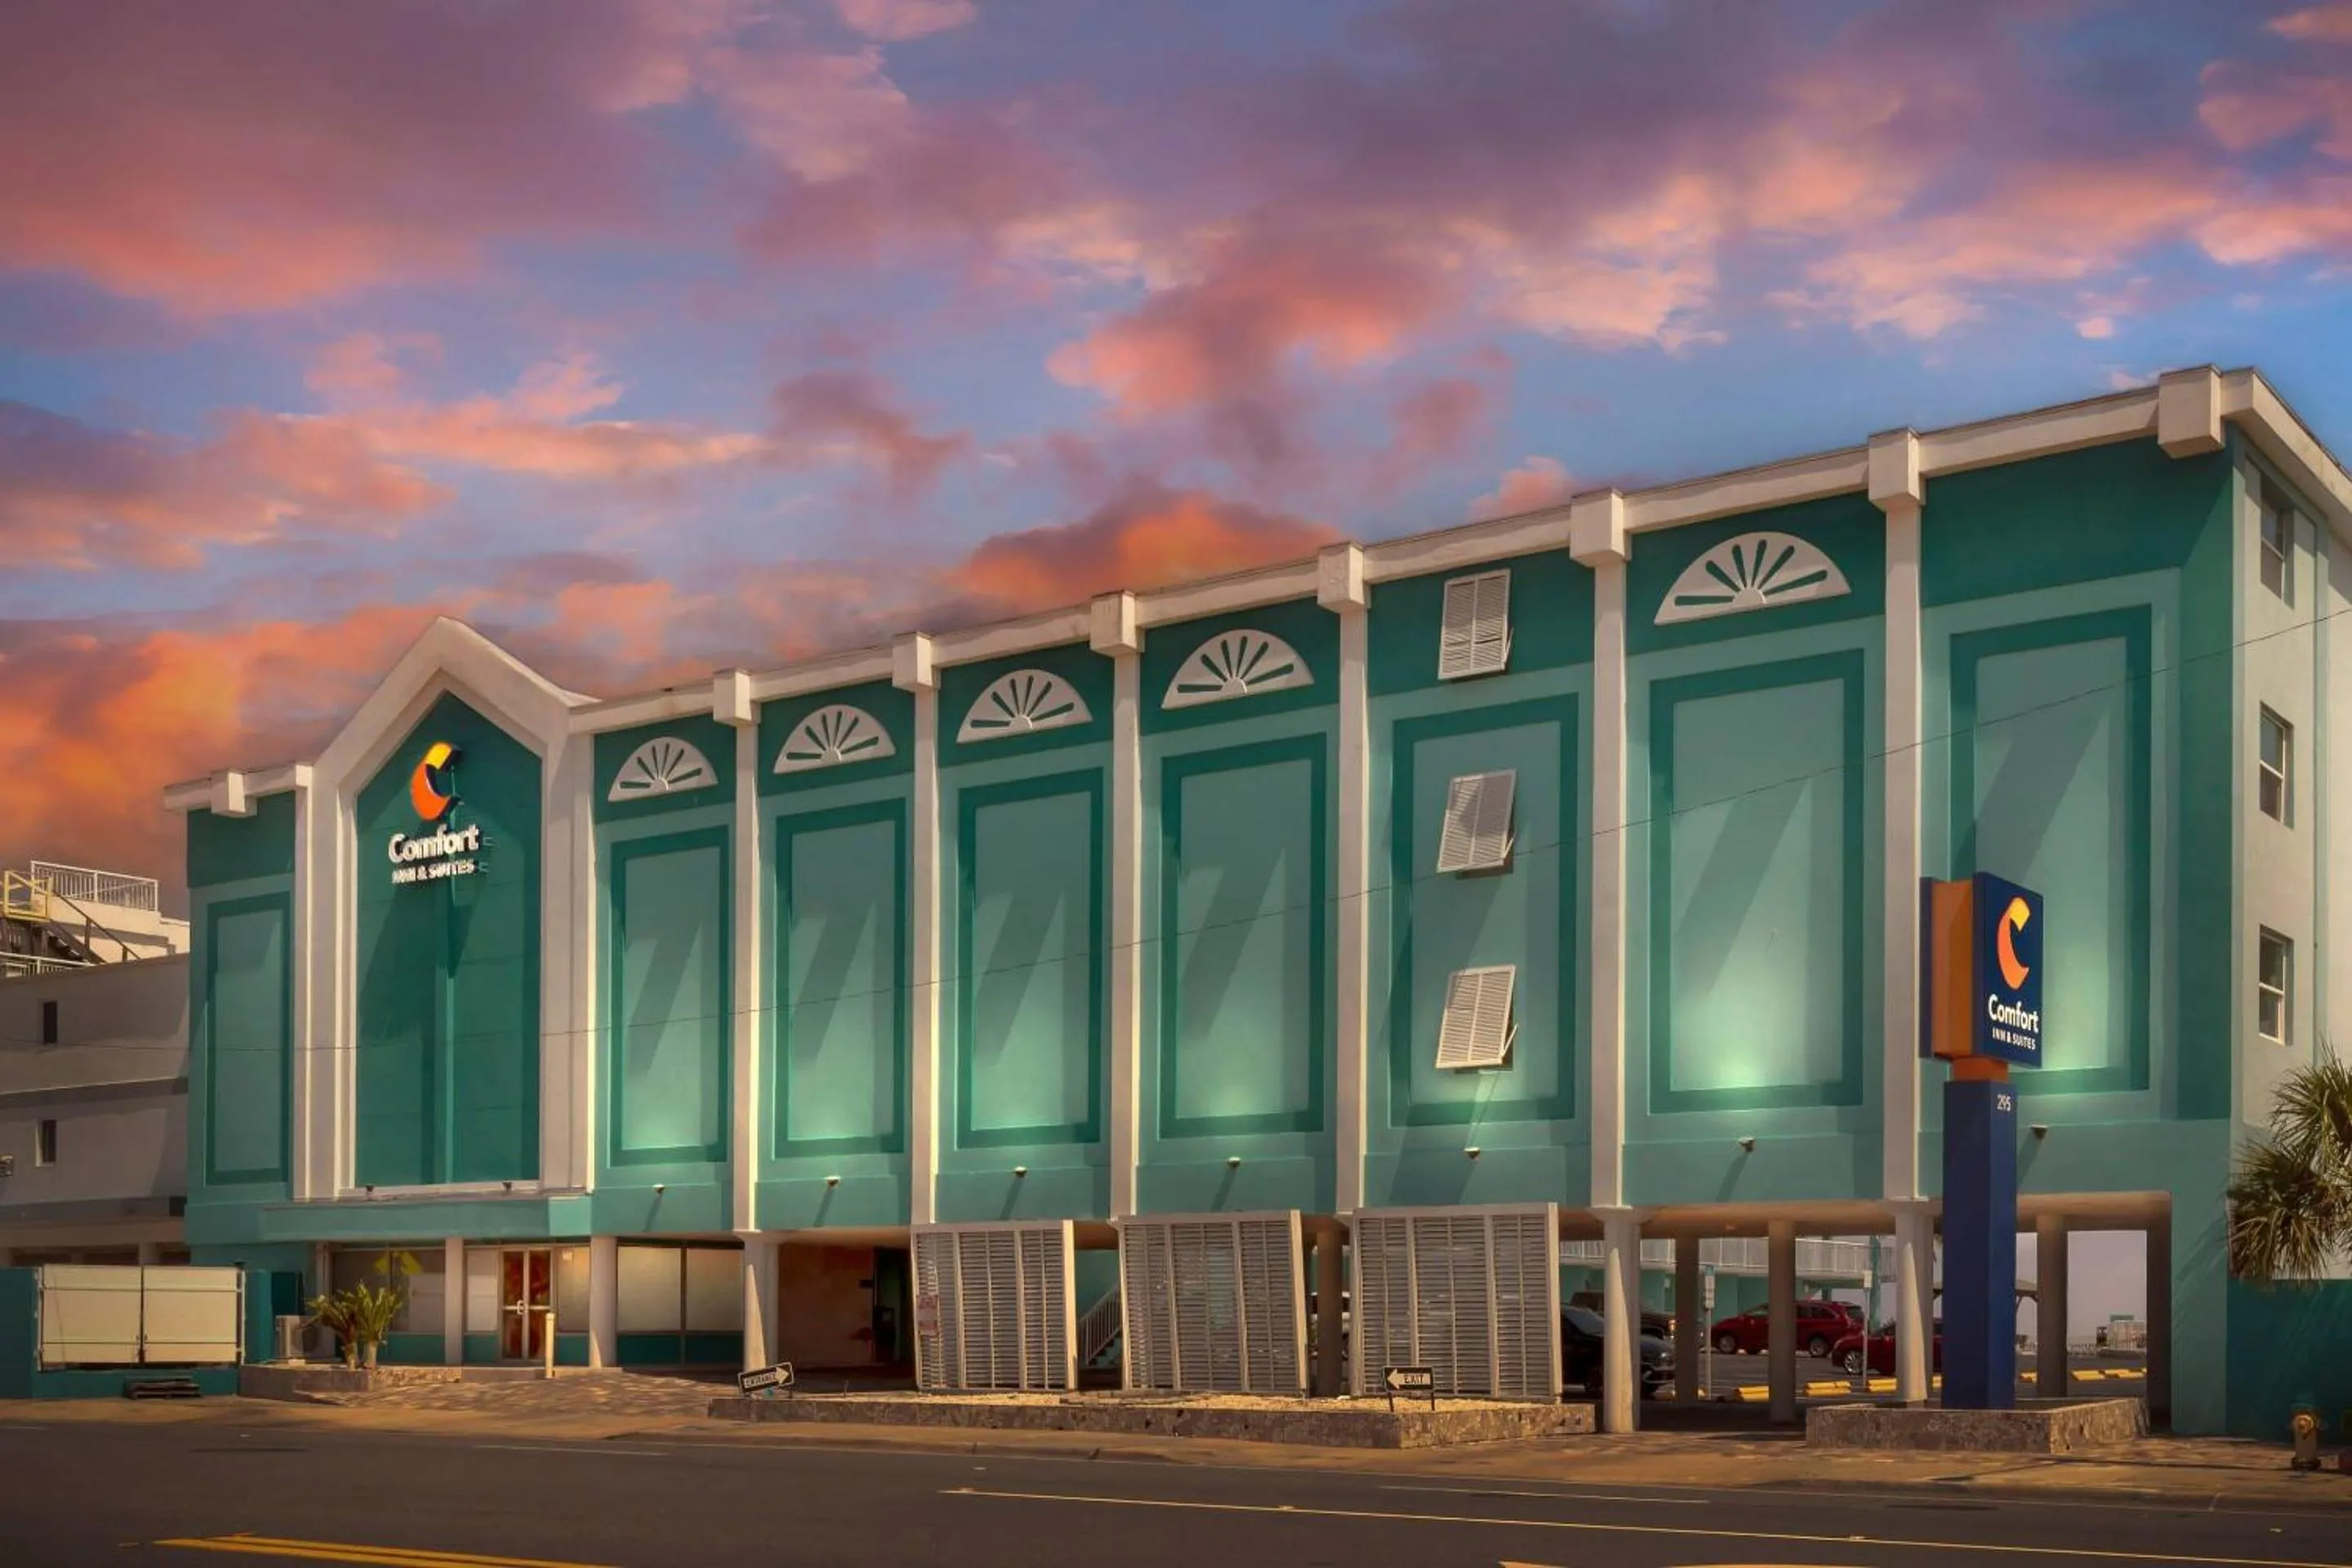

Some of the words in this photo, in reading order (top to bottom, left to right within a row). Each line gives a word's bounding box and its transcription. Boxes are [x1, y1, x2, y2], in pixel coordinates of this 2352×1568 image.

[389, 823, 479, 863] Comfort
[392, 867, 416, 884] INN
[417, 866, 427, 880] &
[430, 859, 475, 879] SUITES
[1988, 993, 2039, 1034] Comfort
[1993, 1027, 2006, 1042] INN
[2007, 1031, 2012, 1044] &
[2013, 1033, 2036, 1050] SUITES
[1997, 1094, 2011, 1111] 295
[1404, 1374, 1424, 1384] EXIT
